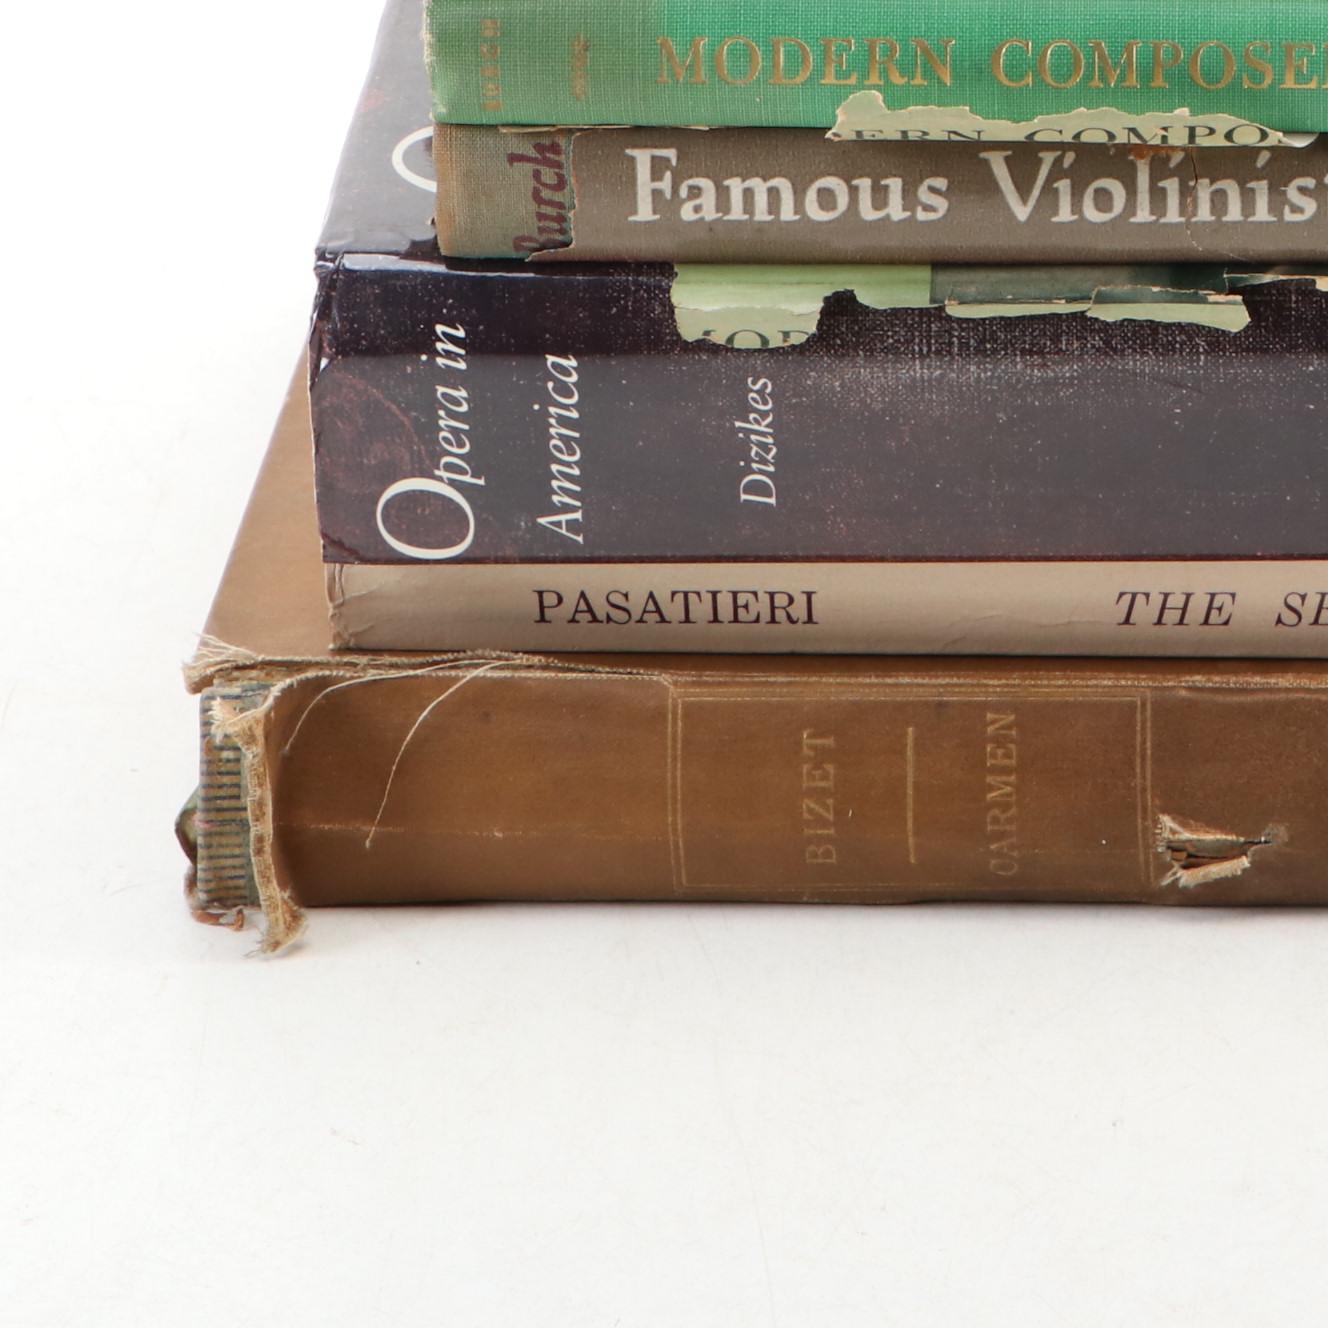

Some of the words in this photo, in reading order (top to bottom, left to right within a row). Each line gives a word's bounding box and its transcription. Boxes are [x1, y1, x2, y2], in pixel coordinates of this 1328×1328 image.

[655, 35, 956, 88] MODERN
[625, 149, 949, 223] Famous
[420, 323, 467, 369] in
[376, 385, 486, 559] Opera
[533, 354, 584, 544] America
[735, 377, 777, 507] Dizikes
[532, 590, 819, 624] PASATIERI
[1115, 591, 1237, 628] THE
[803, 728, 836, 864] BIZET
[986, 711, 1018, 876] CARMEN
